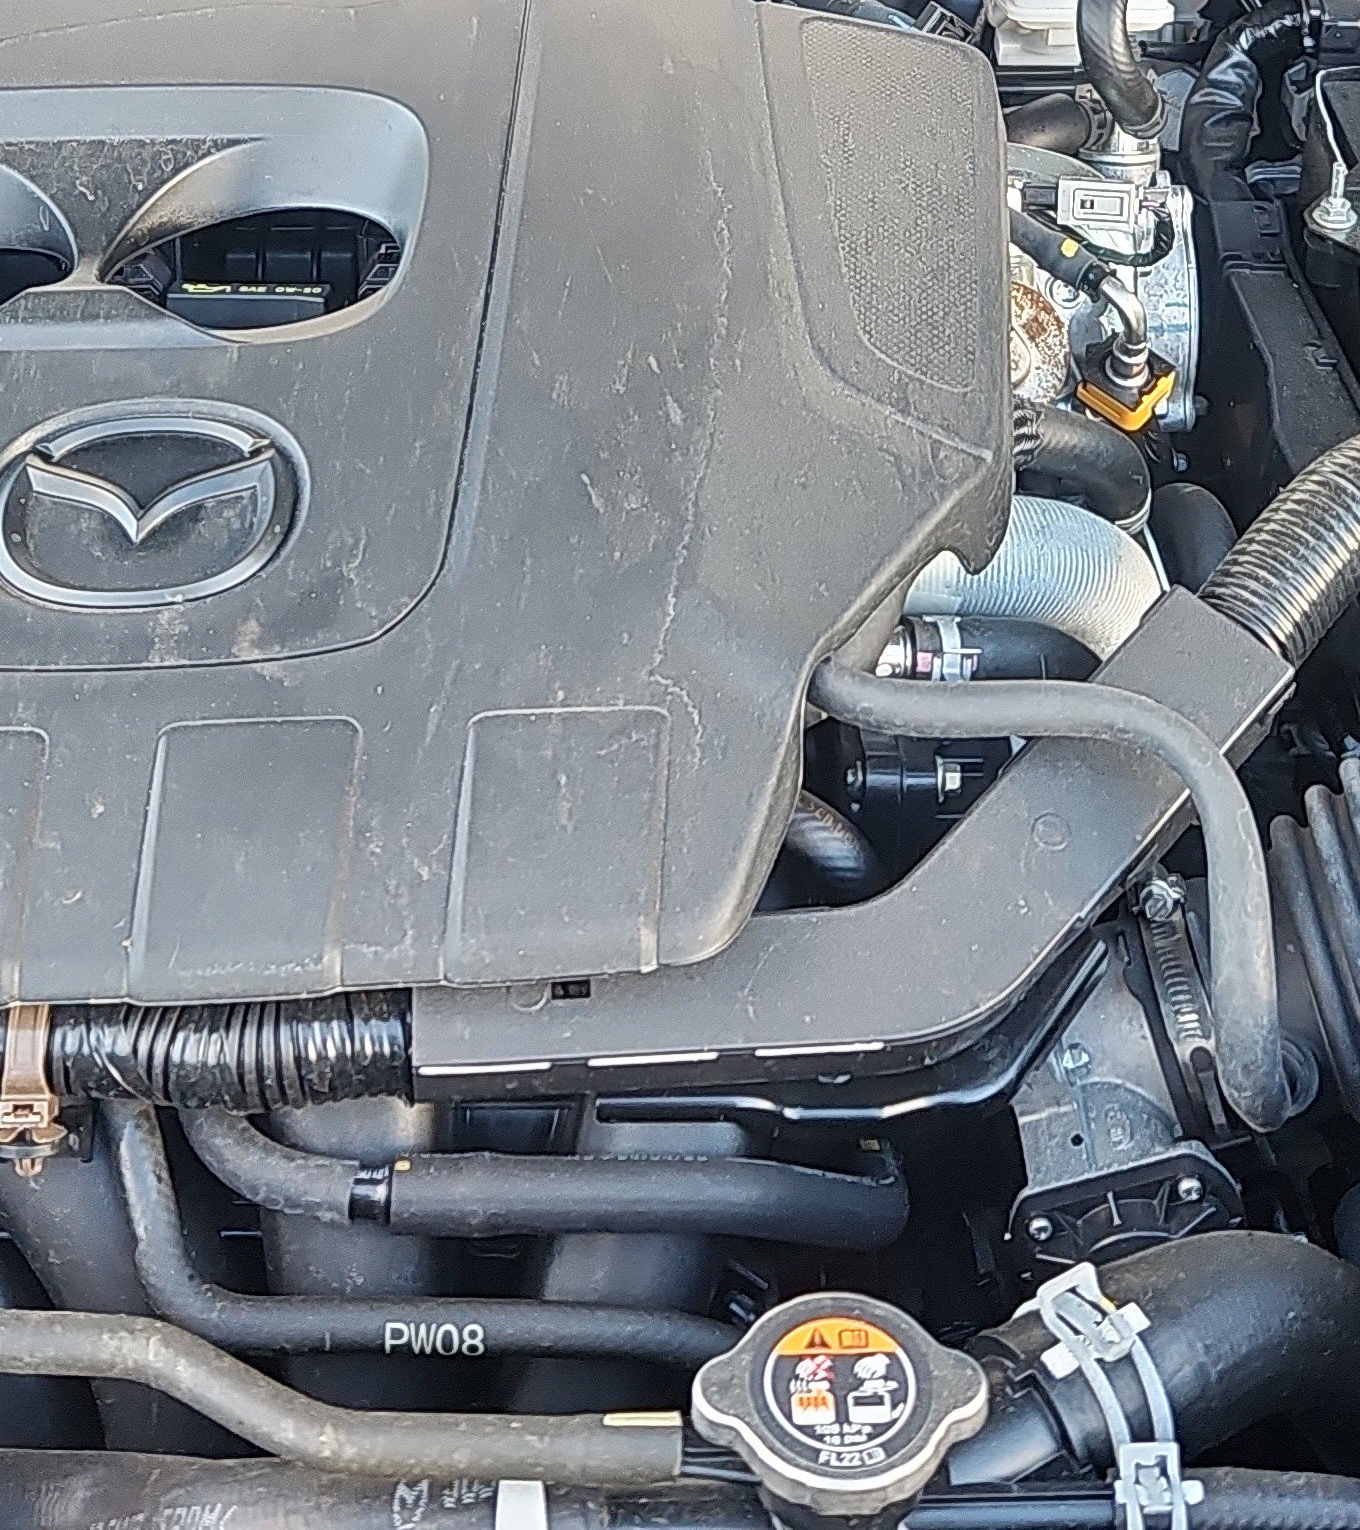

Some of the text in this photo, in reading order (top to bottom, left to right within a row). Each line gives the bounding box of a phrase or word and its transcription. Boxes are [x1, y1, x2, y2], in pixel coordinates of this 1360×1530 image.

[238, 285, 268, 293] SAE
[384, 1322, 485, 1356] PW08
[818, 1450, 863, 1467] FL22
